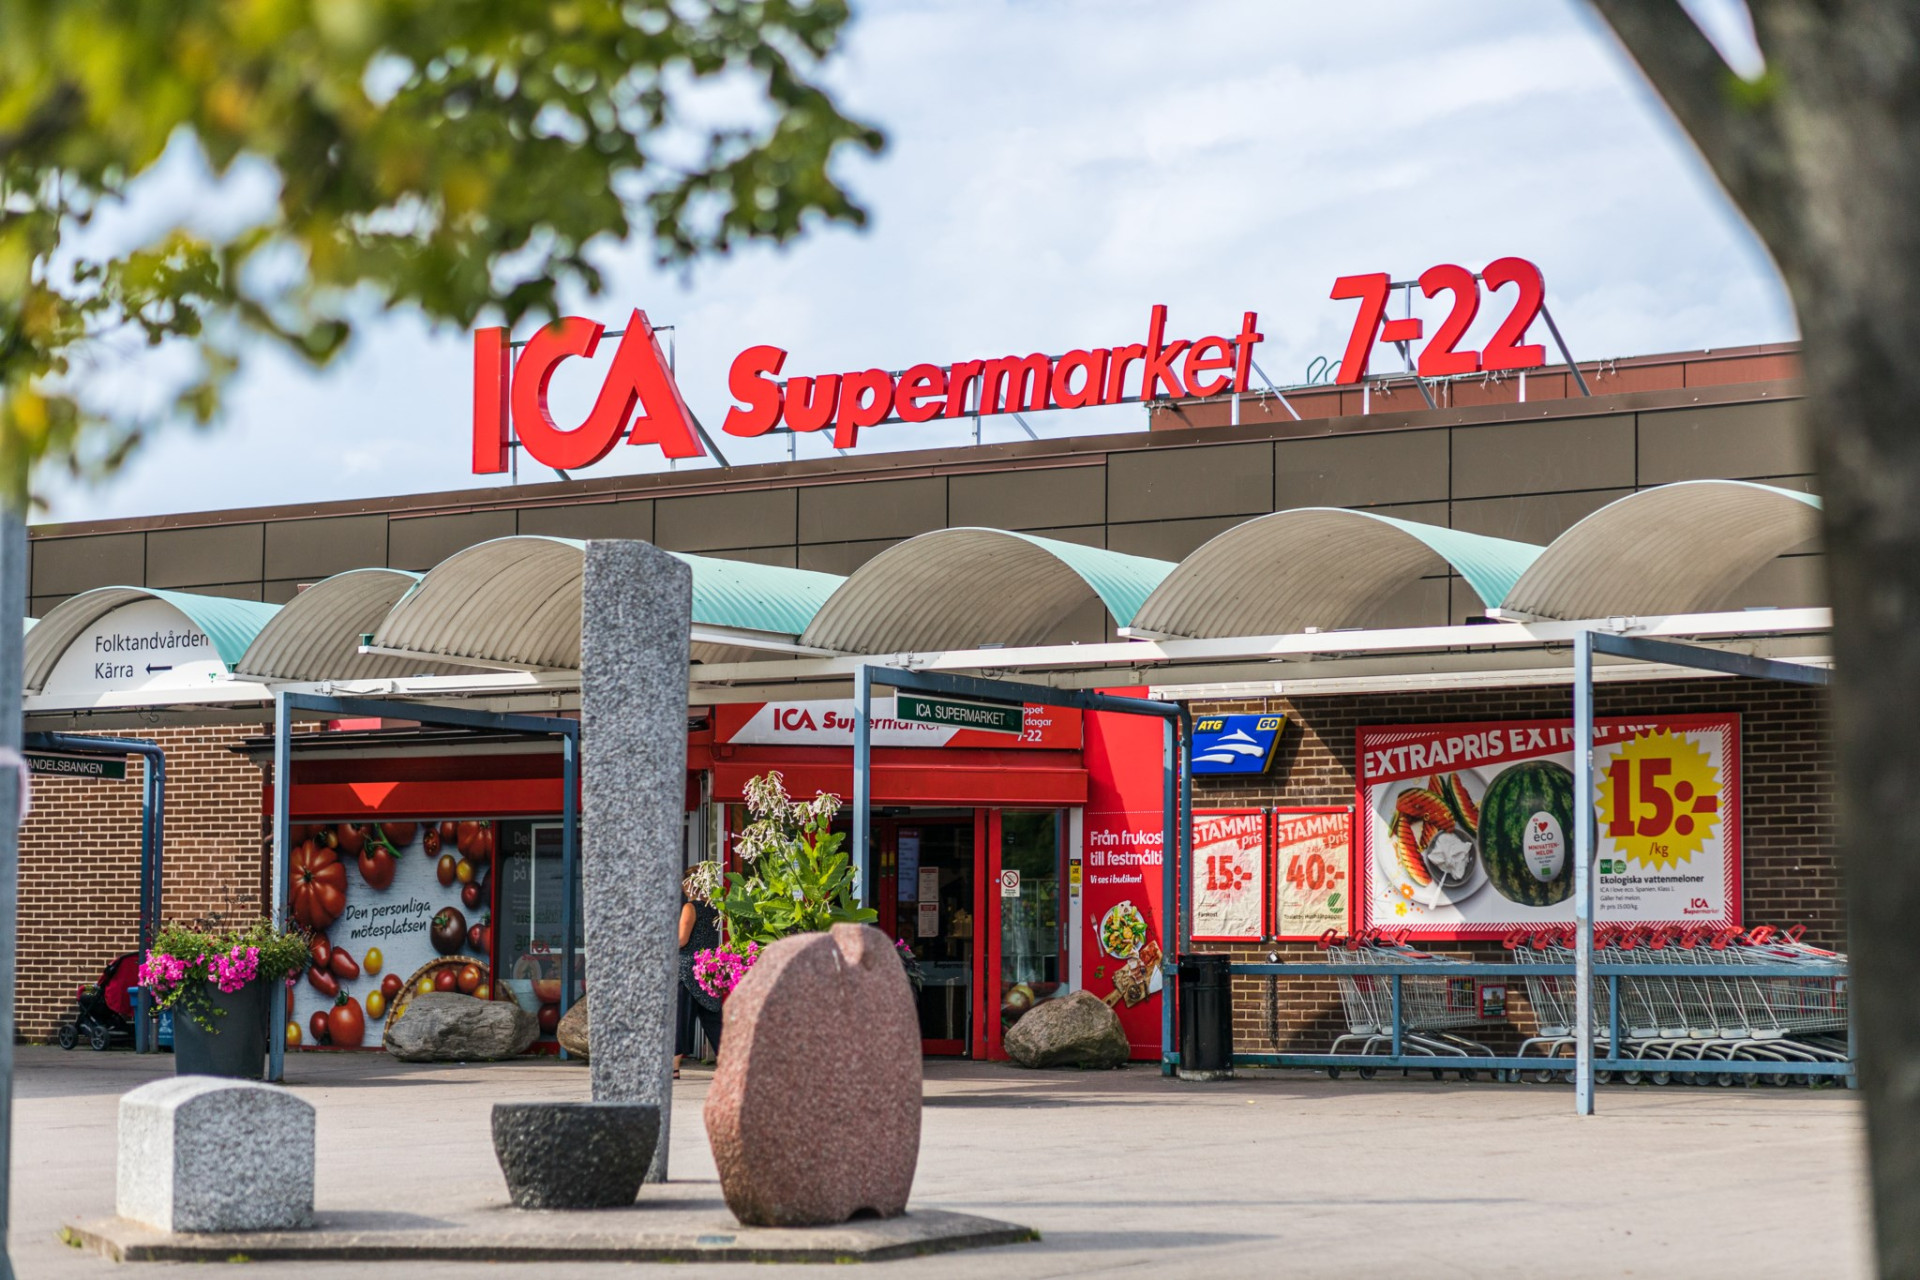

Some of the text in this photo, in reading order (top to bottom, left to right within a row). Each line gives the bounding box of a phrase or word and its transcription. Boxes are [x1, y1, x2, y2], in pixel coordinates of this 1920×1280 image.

[472, 256, 1546, 474] ICA Supermarket 7-22
[95, 630, 209, 653] Folktandvården
[95, 662, 134, 679] Kärra
[774, 708, 817, 731] ICA
[916, 703, 1005, 725] ICA SUPERMARKET
[1023, 706, 1044, 716] ppet
[1025, 717, 1052, 728] dagar
[1198, 719, 1278, 731] ATG GO
[1364, 730, 1505, 778] EXTRAPRIS
[1608, 758, 1718, 837] 15:-
[1090, 829, 1119, 846] Från
[1193, 815, 1262, 844] STAMMIS
[1278, 814, 1349, 844] STAMMIS
[1533, 832, 1554, 842] eco
[1090, 849, 1164, 866] till festmålti
[1649, 842, 1669, 858] /kg
[1206, 855, 1253, 891] 15:-
[1286, 854, 1345, 890] 40:-
[1600, 874, 1704, 886] Ekologiska vattenmeloner
[346, 897, 431, 927] Den personliga
[1690, 898, 1709, 908] ICA
[350, 917, 426, 940] mötesplatsen
